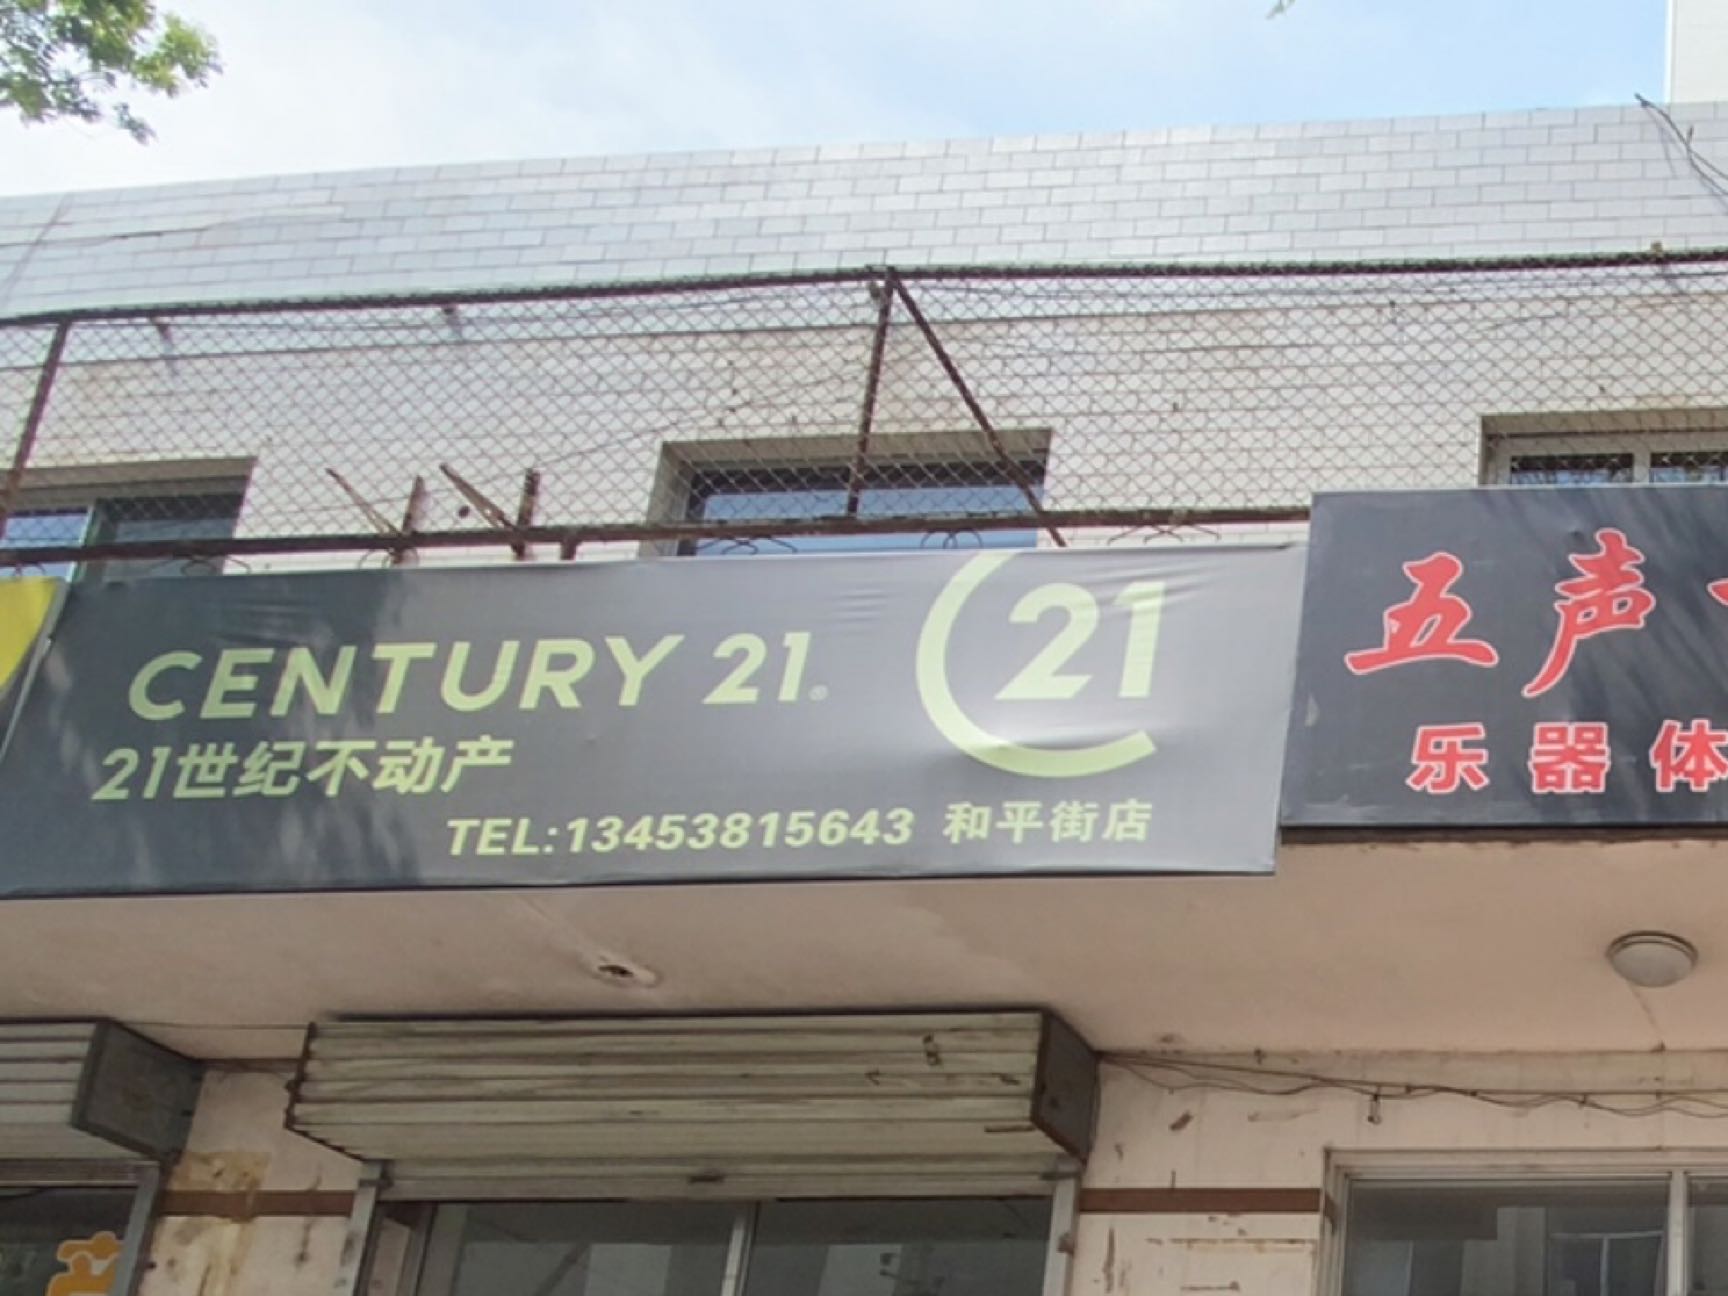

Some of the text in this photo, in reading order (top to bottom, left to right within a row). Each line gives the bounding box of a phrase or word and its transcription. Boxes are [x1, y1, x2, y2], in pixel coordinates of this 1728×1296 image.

[129, 634, 685, 721] CENTURY
[92, 734, 515, 801] 21世纪不动产
[447, 799, 1153, 858] TEL:13453815643 和平街店
